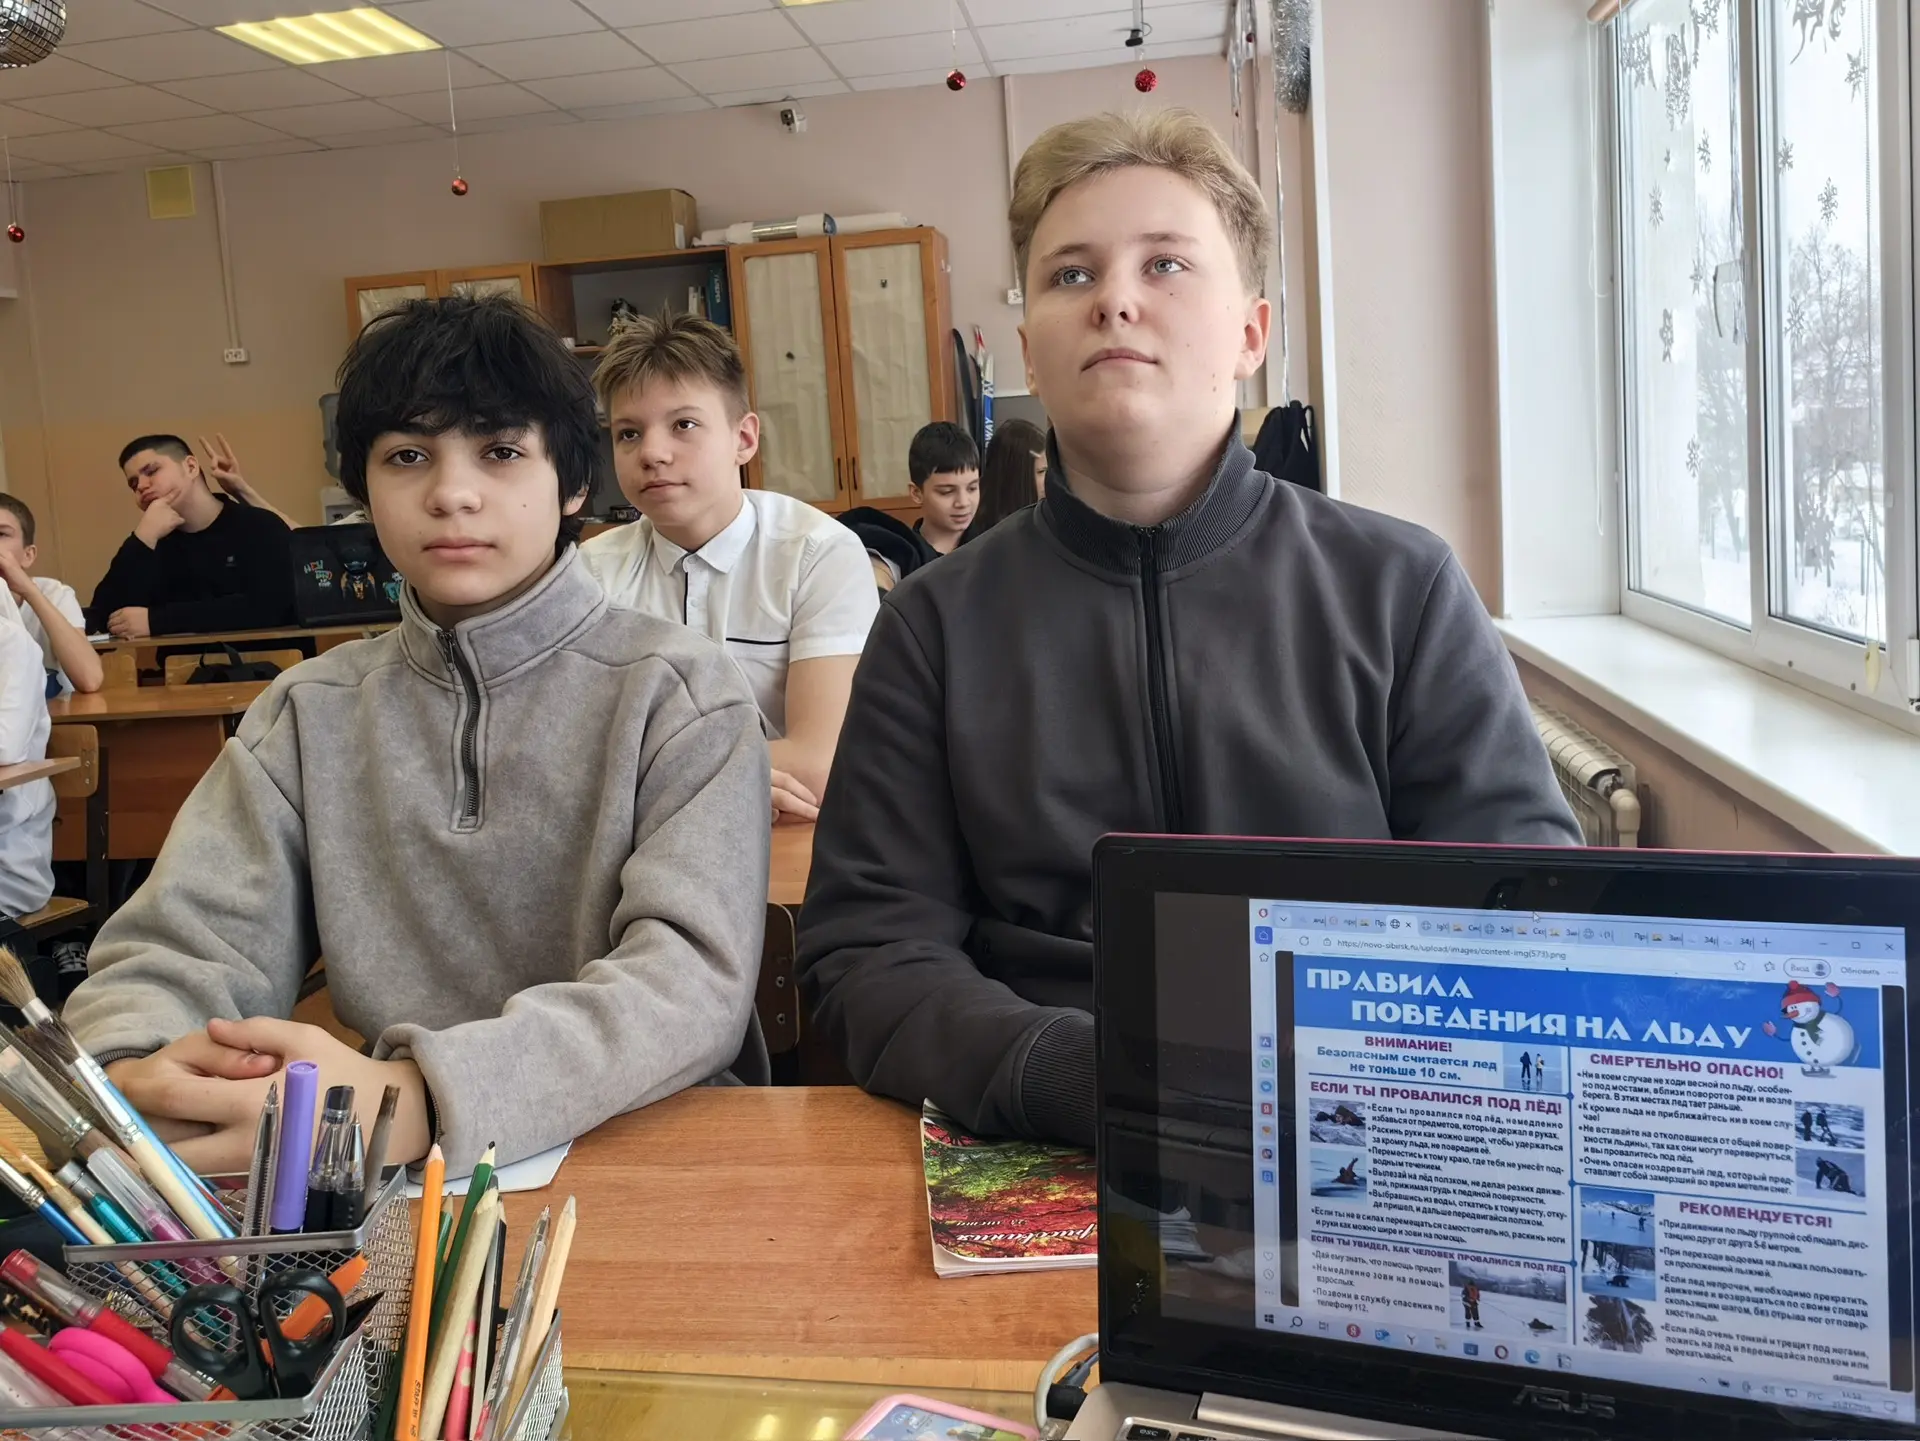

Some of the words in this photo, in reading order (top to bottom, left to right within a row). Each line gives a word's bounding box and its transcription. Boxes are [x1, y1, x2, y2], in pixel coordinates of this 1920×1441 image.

[1306, 968, 1474, 999] ПРАВИЛА
[1351, 1000, 1567, 1036] ПОВЕДЕНИЯ
[1576, 1015, 1631, 1042] НА
[1642, 1021, 1751, 1049] ЛЬДУ
[1316, 1046, 1398, 1062] Безопасным
[1402, 1055, 1468, 1068] считается
[1364, 1035, 1452, 1052] ВНИМАНИЕ!
[1349, 1063, 1365, 1072] не
[1369, 1065, 1416, 1076] тоньше
[1420, 1067, 1435, 1078] 10
[1439, 1071, 1461, 1080] см.
[1589, 1052, 1701, 1072] СМЕРТЕЛЬНО
[1706, 1061, 1784, 1079] ОПАСНО!
[1310, 1081, 1348, 1093] ЕСЛИ
[1355, 1085, 1375, 1096] ТЫ
[1380, 1087, 1482, 1105] ПРОВАЛИЛСЯ
[1487, 1097, 1520, 1110] ПОД
[1525, 1099, 1562, 1114] ЛЁД!
[1679, 1201, 1832, 1228] РЕКОМЕНДУЕТСЯ!
